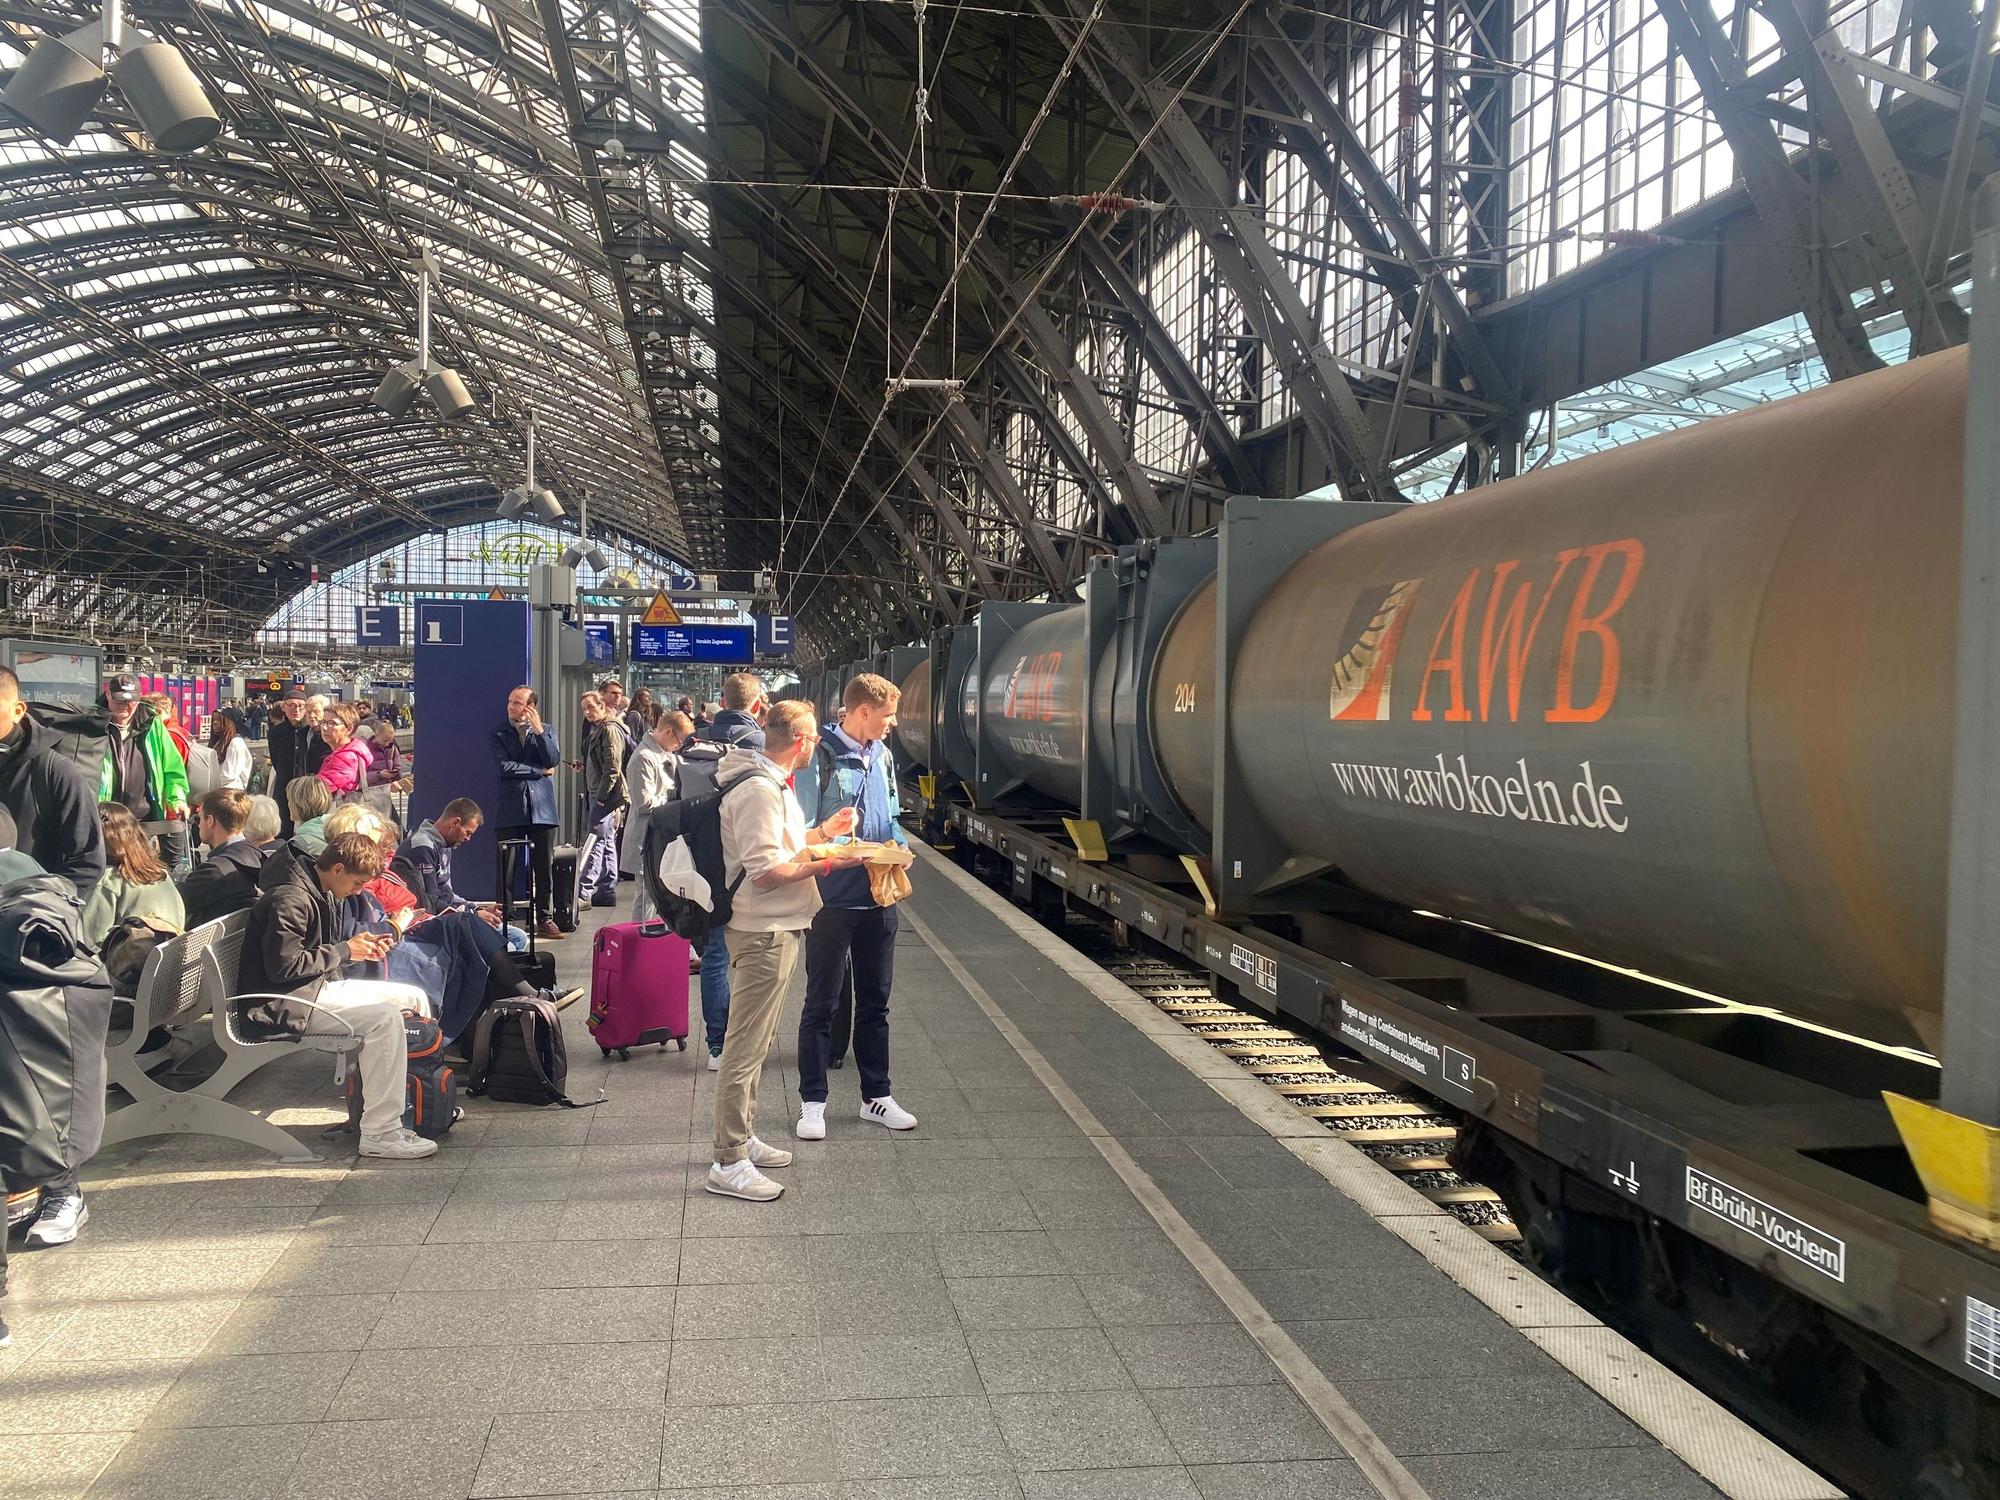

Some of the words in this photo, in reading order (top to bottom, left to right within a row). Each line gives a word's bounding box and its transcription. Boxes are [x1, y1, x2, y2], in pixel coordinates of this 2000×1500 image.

[682, 576, 696, 591] 2
[361, 607, 381, 636] E
[771, 615, 789, 645] E
[1411, 537, 1646, 723] AWB
[296, 675, 304, 684] D
[1175, 683, 1196, 713] 204
[1331, 754, 1629, 833] www.awbkoeln.de
[1341, 999, 1359, 1018] Wagen
[1358, 1012, 1368, 1024] nur
[1368, 1015, 1378, 1028] mit
[1377, 1018, 1408, 1044] Containern
[1408, 1032, 1440, 1061] befördern,
[1340, 1022, 1369, 1044] andernfalls
[1368, 1034, 1390, 1055] Bremse
[1390, 1047, 1428, 1075] ausschalten.
[1461, 1063, 1469, 1081] S
